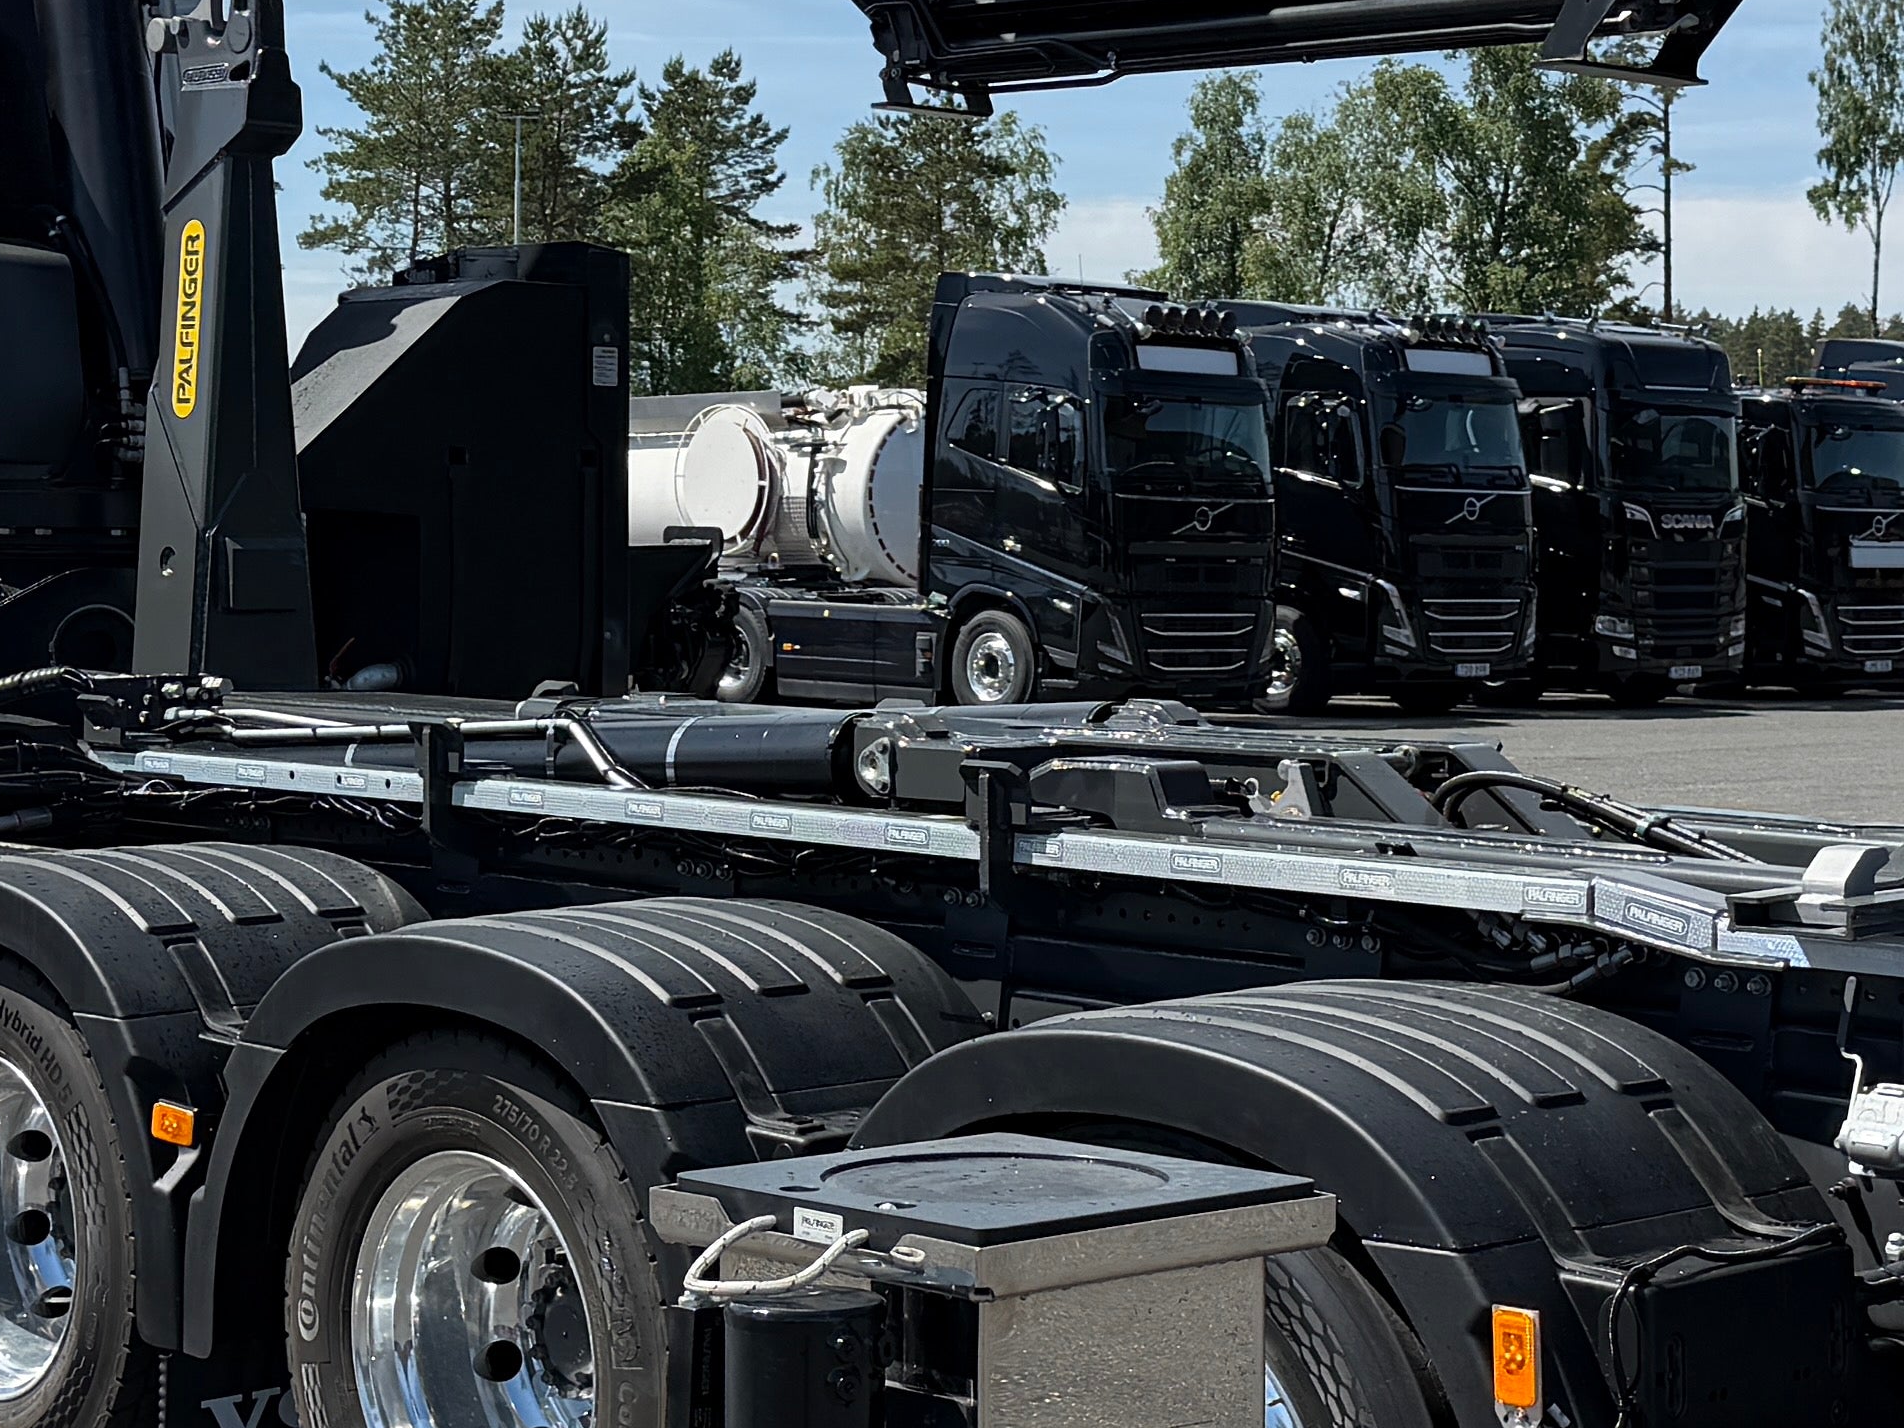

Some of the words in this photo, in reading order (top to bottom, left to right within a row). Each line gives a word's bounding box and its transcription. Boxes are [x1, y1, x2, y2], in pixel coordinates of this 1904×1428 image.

[176, 234, 200, 404] PALFINGER
[1661, 514, 1714, 529] SCANIA
[1629, 906, 1686, 933] PALFINGER
[40, 1046, 61, 1089] HD
[59, 1086, 73, 1103] 5
[494, 1094, 540, 1142] 275/70
[540, 1136, 552, 1153] R
[549, 1148, 576, 1191] 22.5
[298, 1121, 364, 1342] Continental
